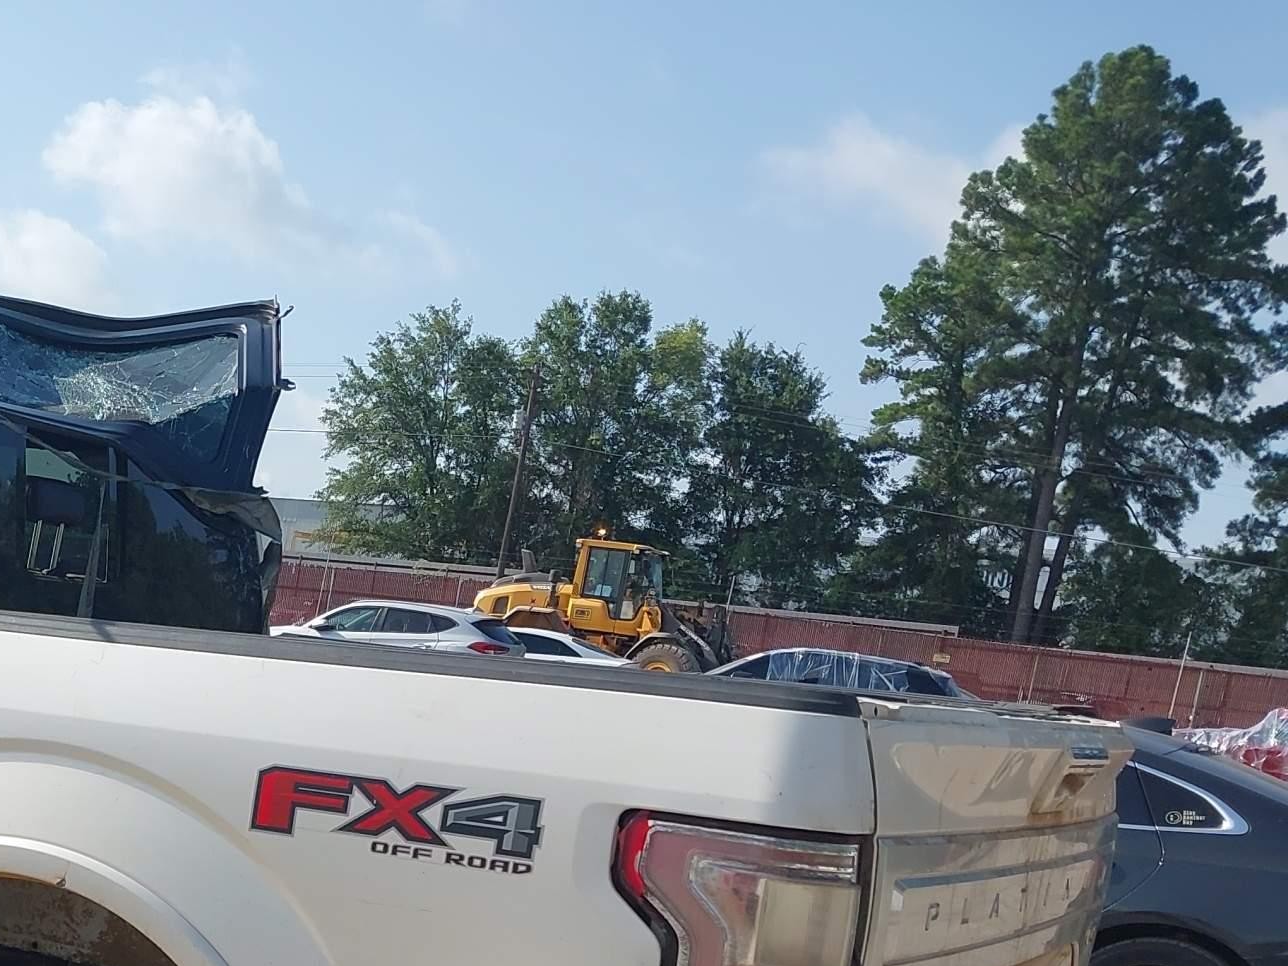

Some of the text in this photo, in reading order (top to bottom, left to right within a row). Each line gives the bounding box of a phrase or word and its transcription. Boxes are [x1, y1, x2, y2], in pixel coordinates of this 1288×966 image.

[249, 763, 545, 862] FX4
[371, 841, 532, 874] OFF ROAD
